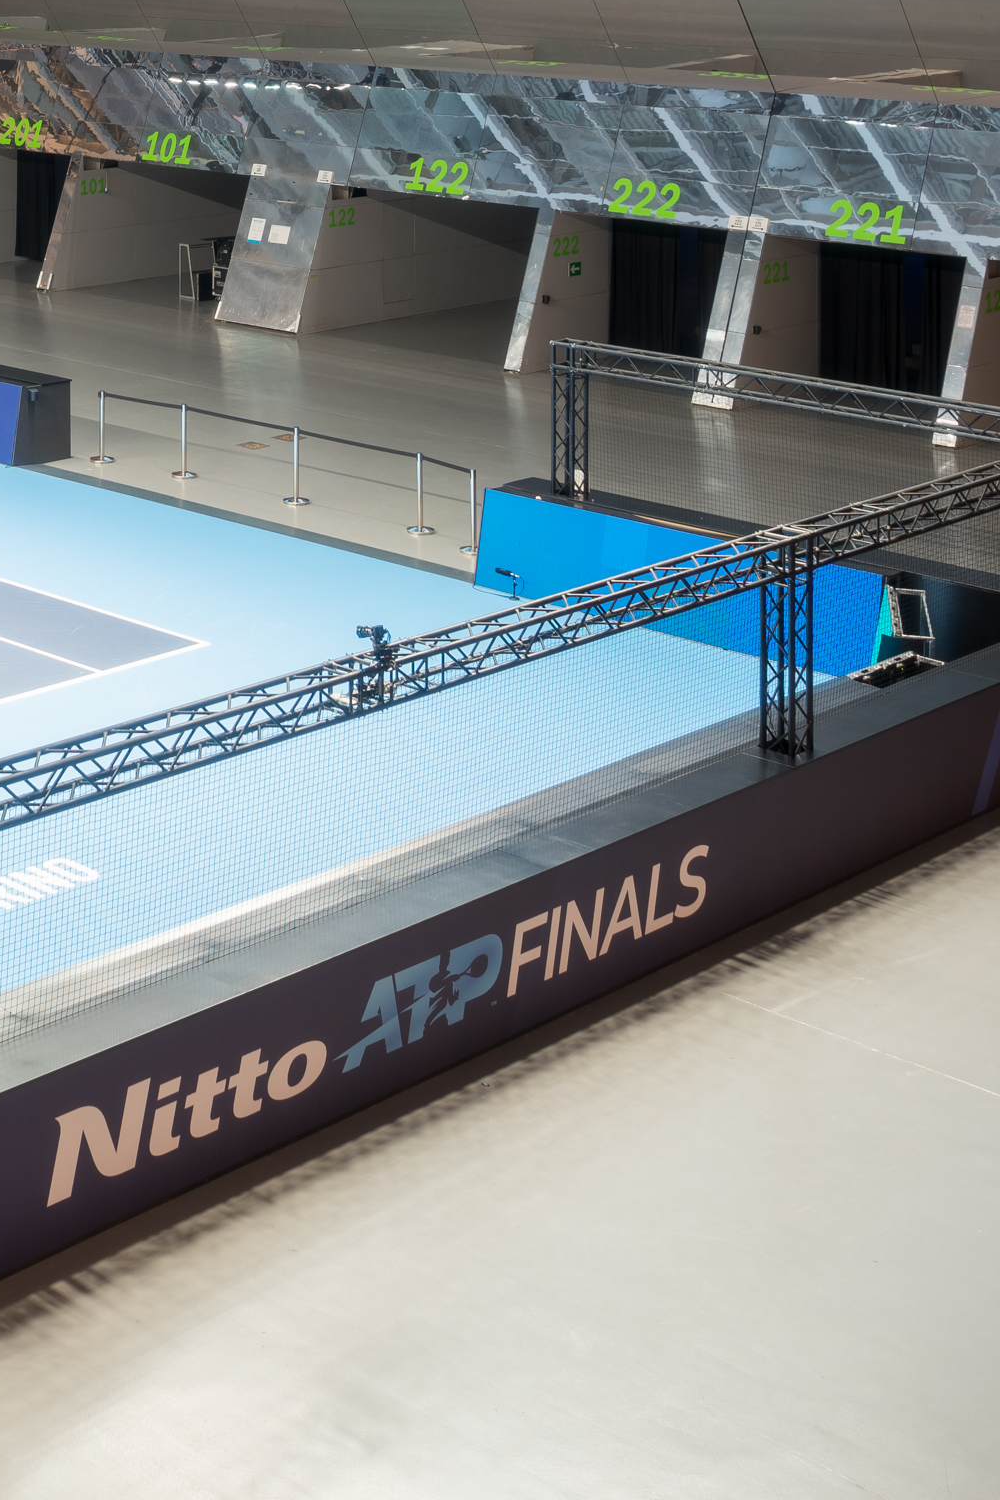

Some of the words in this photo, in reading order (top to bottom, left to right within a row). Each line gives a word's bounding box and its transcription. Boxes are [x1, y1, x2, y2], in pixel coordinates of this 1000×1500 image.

[142, 131, 192, 165] 101
[80, 177, 106, 196] 101
[405, 157, 469, 195] 122
[608, 177, 681, 219] 222
[328, 207, 356, 228] 122
[824, 199, 907, 245] 221
[553, 235, 580, 257] 222
[763, 260, 790, 284] 221
[46, 1039, 327, 1208] Nitto
[331, 932, 504, 1074] ATP
[506, 843, 710, 998] FINALS
